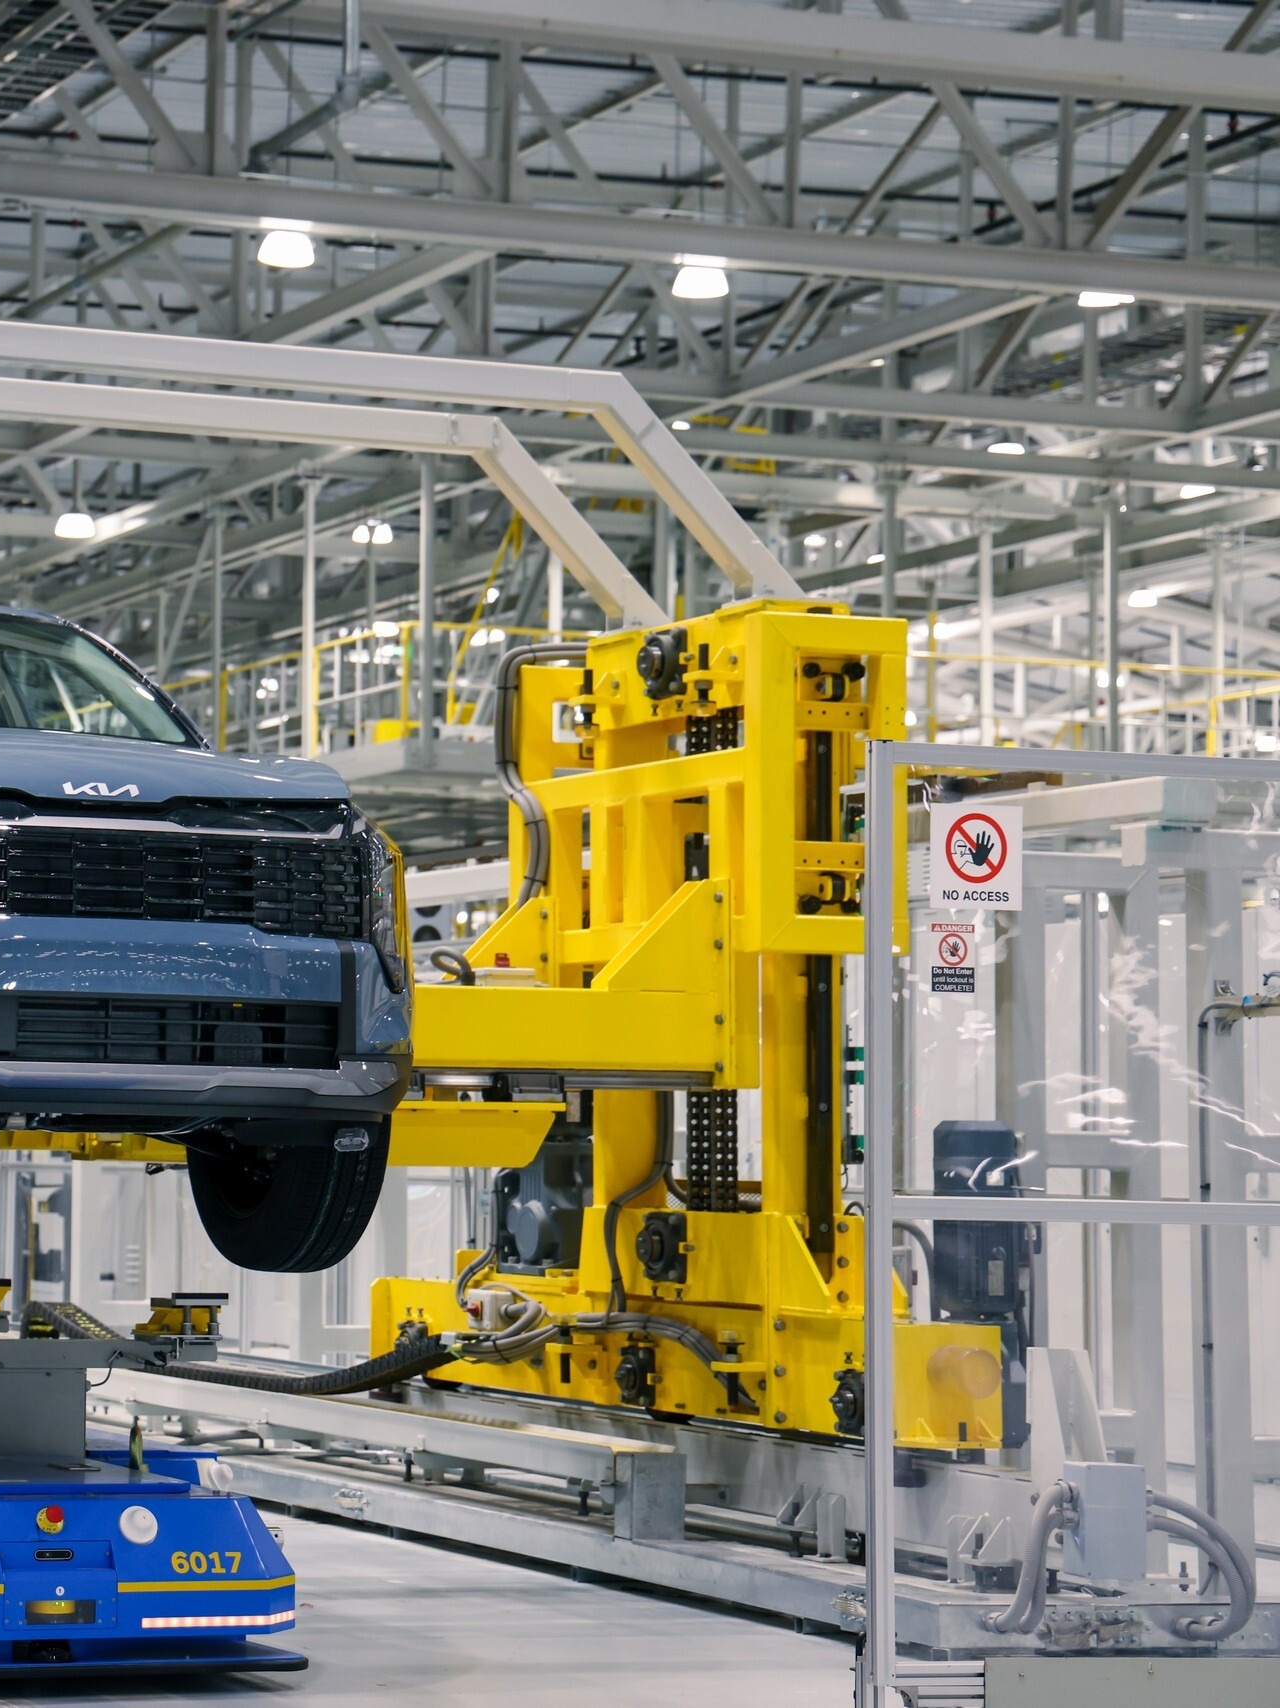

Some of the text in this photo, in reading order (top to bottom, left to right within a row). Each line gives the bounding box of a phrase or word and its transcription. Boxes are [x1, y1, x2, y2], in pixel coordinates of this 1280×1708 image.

[62, 781, 140, 798] KIA
[942, 890, 1009, 902] NO ACCESS
[941, 924, 973, 932] DANGER
[170, 1551, 242, 1574] 6017
